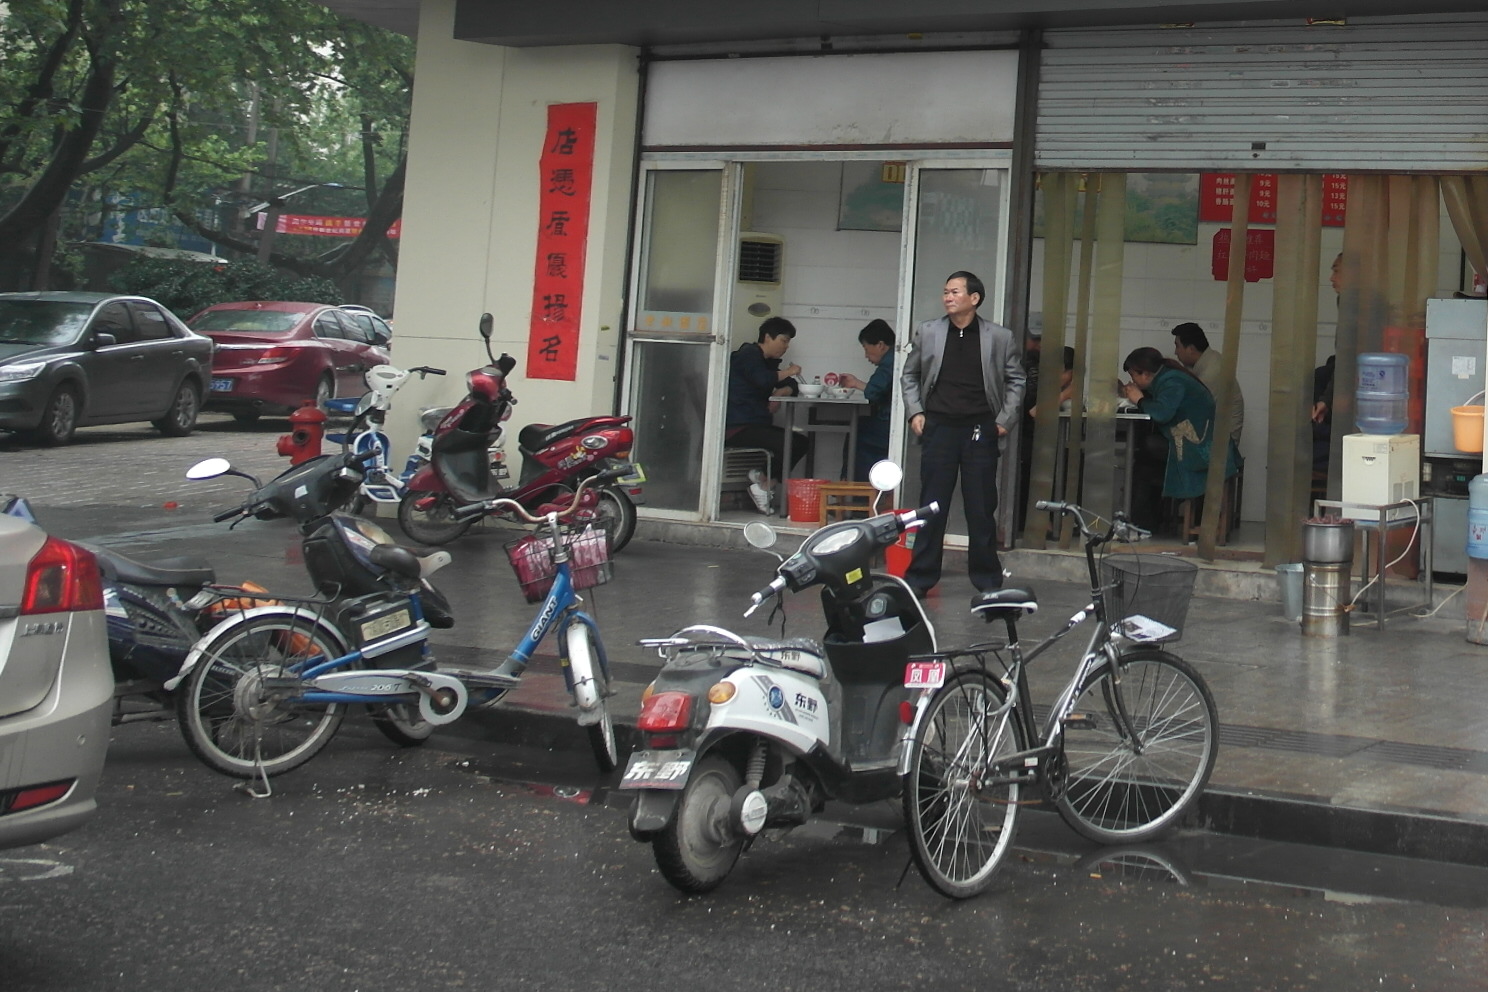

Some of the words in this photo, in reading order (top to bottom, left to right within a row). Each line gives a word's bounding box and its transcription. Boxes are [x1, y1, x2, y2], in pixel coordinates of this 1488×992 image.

[530, 595, 558, 642] GIANT
[909, 668, 941, 684] 凤凰
[794, 692, 818, 713] 东野
[623, 760, 692, 781] 东野
